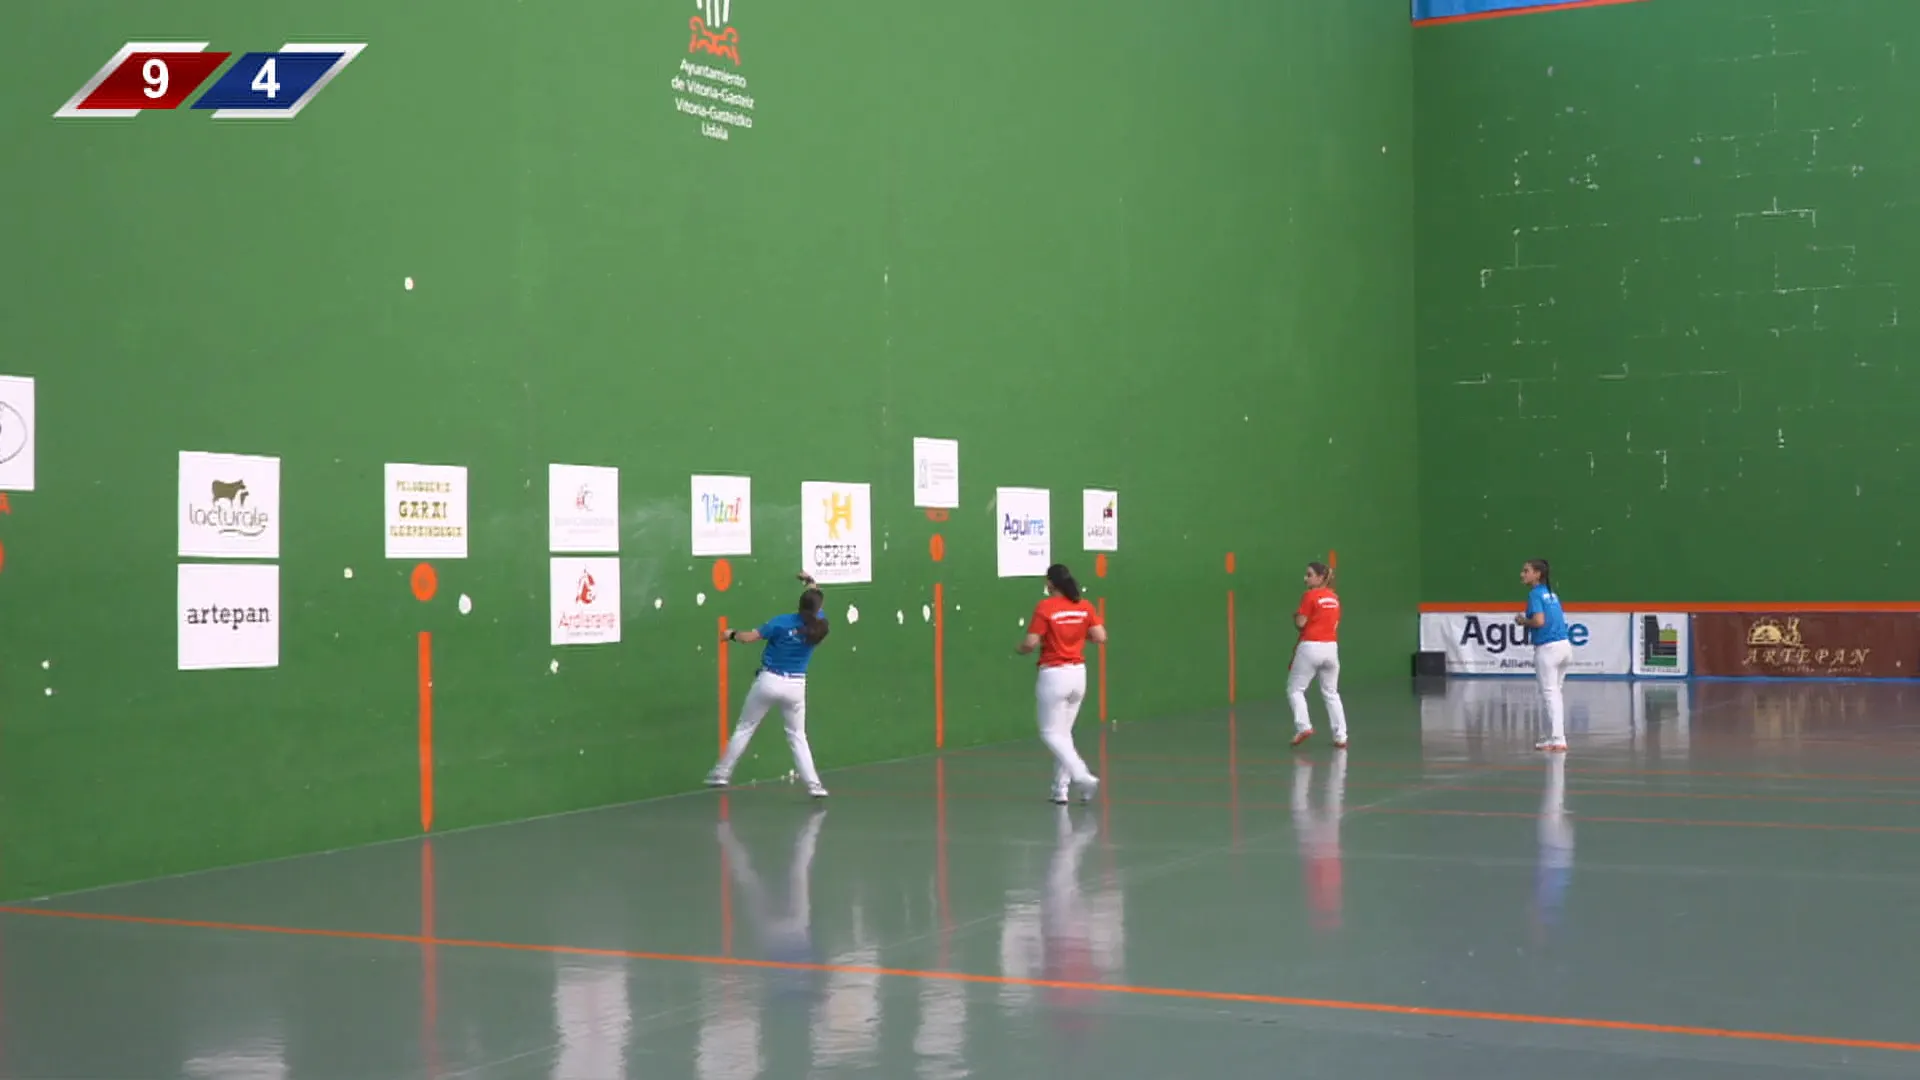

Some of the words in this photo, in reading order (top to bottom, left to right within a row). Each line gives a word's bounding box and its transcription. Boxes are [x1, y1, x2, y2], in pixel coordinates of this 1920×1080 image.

[680, 58, 747, 88] Ayuntamiento
[671, 75, 686, 91] de
[686, 79, 755, 109] Vitoria-Gasteiz
[675, 97, 753, 128] Vitoria-Gasteizko
[701, 121, 729, 140] Udala
[188, 503, 269, 526] lacturale
[399, 500, 448, 518] GARAI
[701, 492, 742, 524] Vital
[1003, 512, 1045, 541] Aguirre
[186, 604, 270, 630] artepan
[1460, 615, 1590, 654] Ague
[1742, 648, 1871, 665] ARTEPAN
